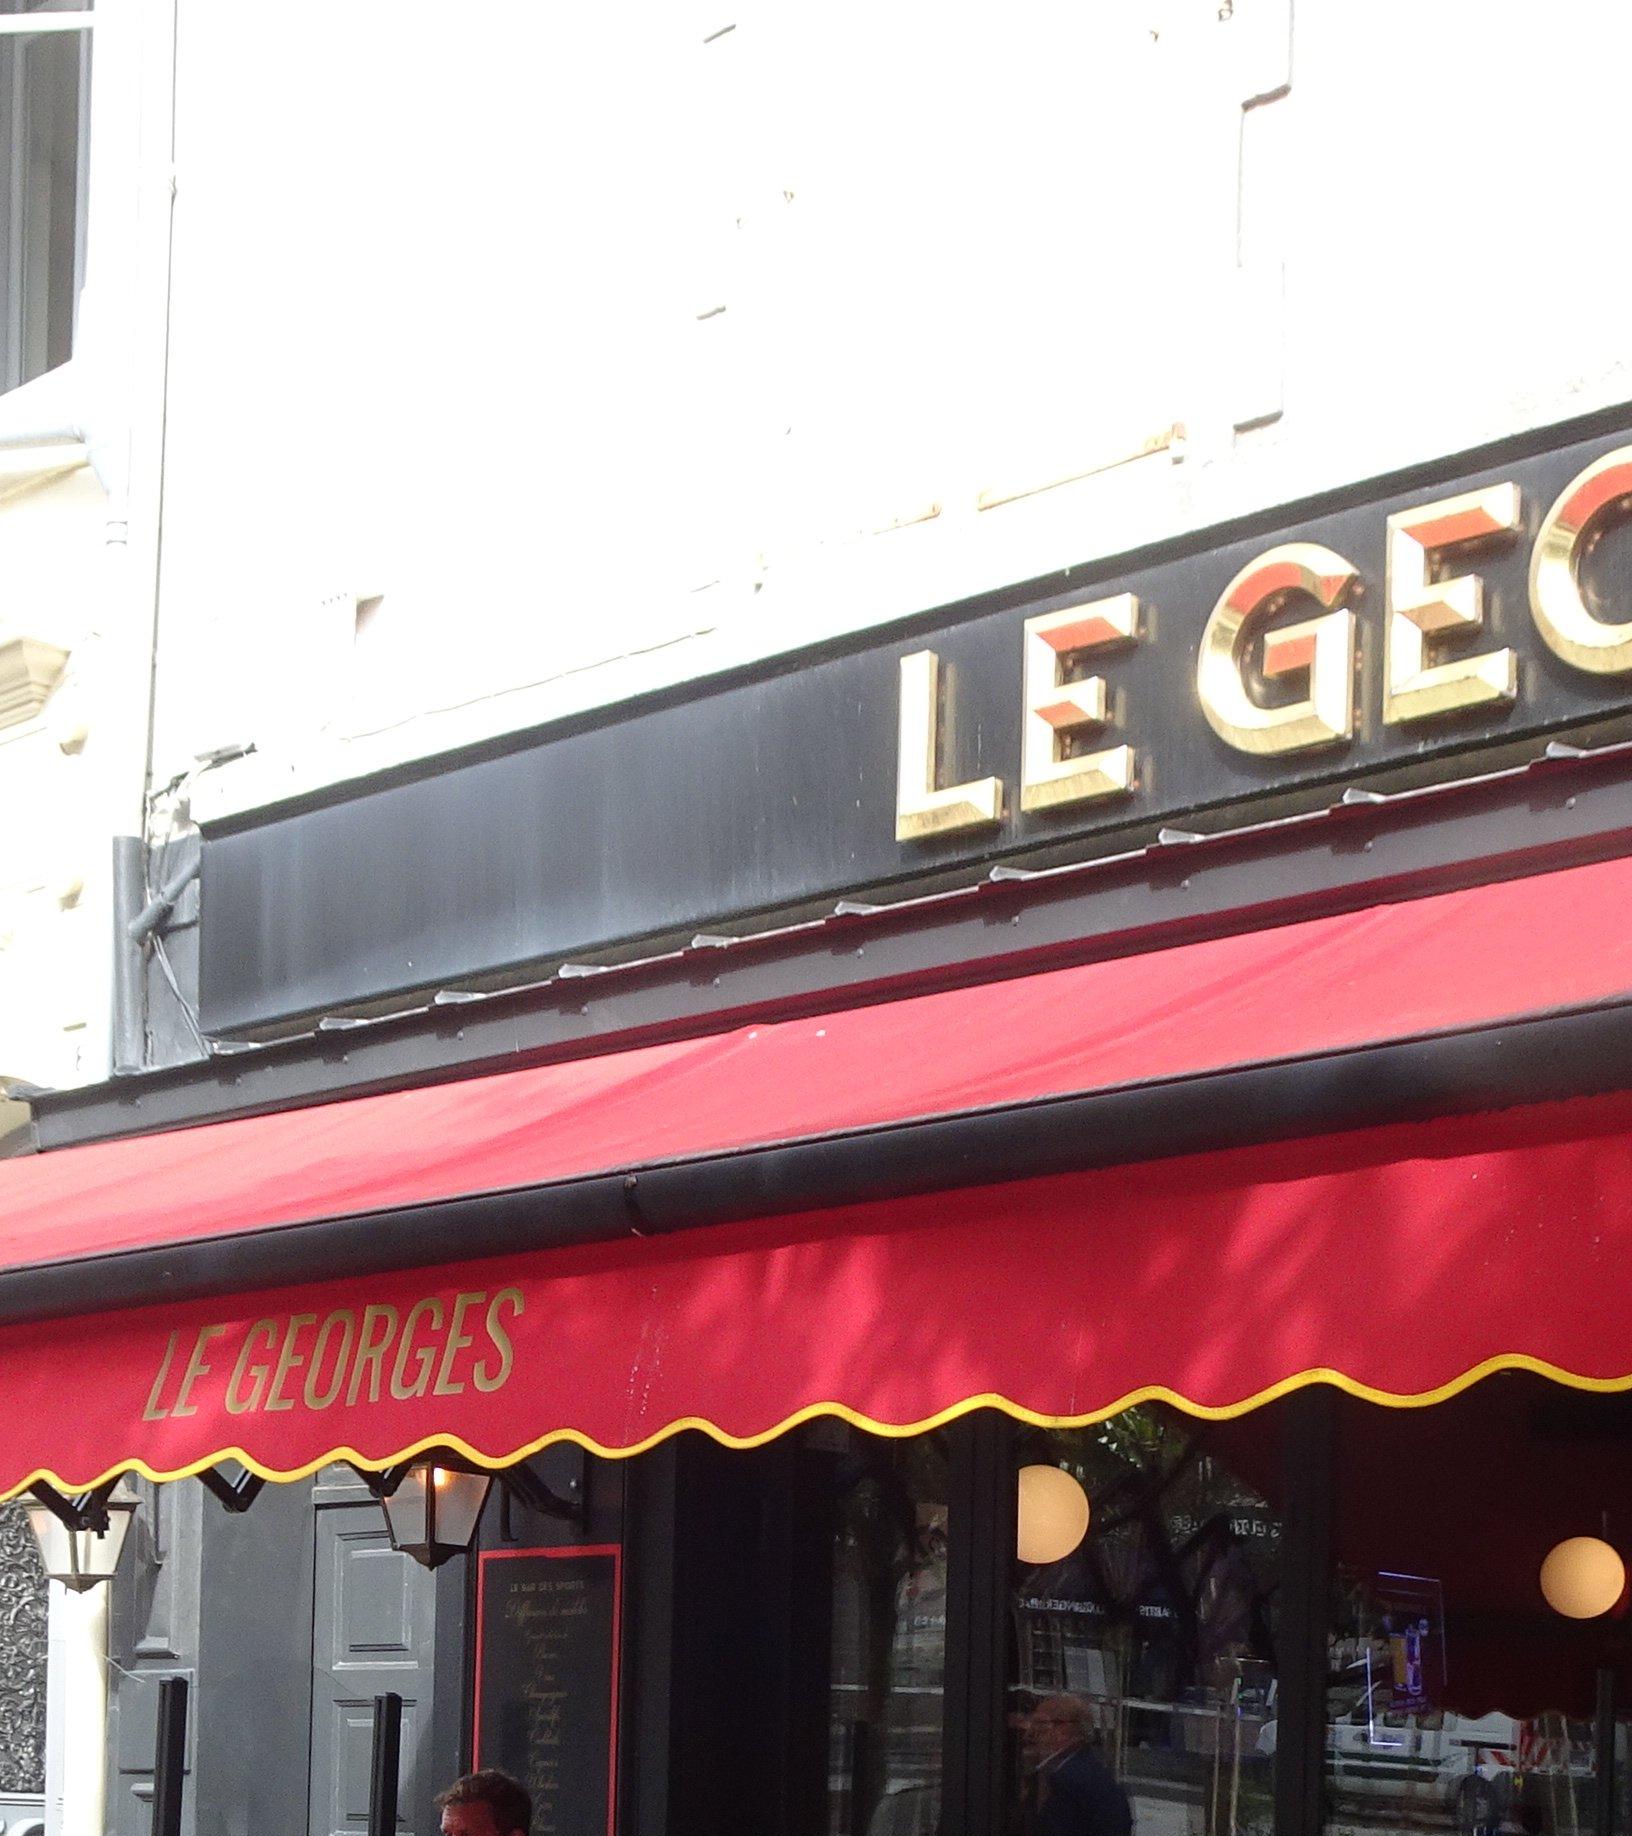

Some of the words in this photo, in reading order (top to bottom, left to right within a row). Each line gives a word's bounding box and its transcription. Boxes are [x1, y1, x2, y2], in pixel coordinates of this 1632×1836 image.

[895, 592, 1139, 842] LE
[141, 1323, 229, 1422] LE
[224, 1287, 526, 1416] GEORGES
